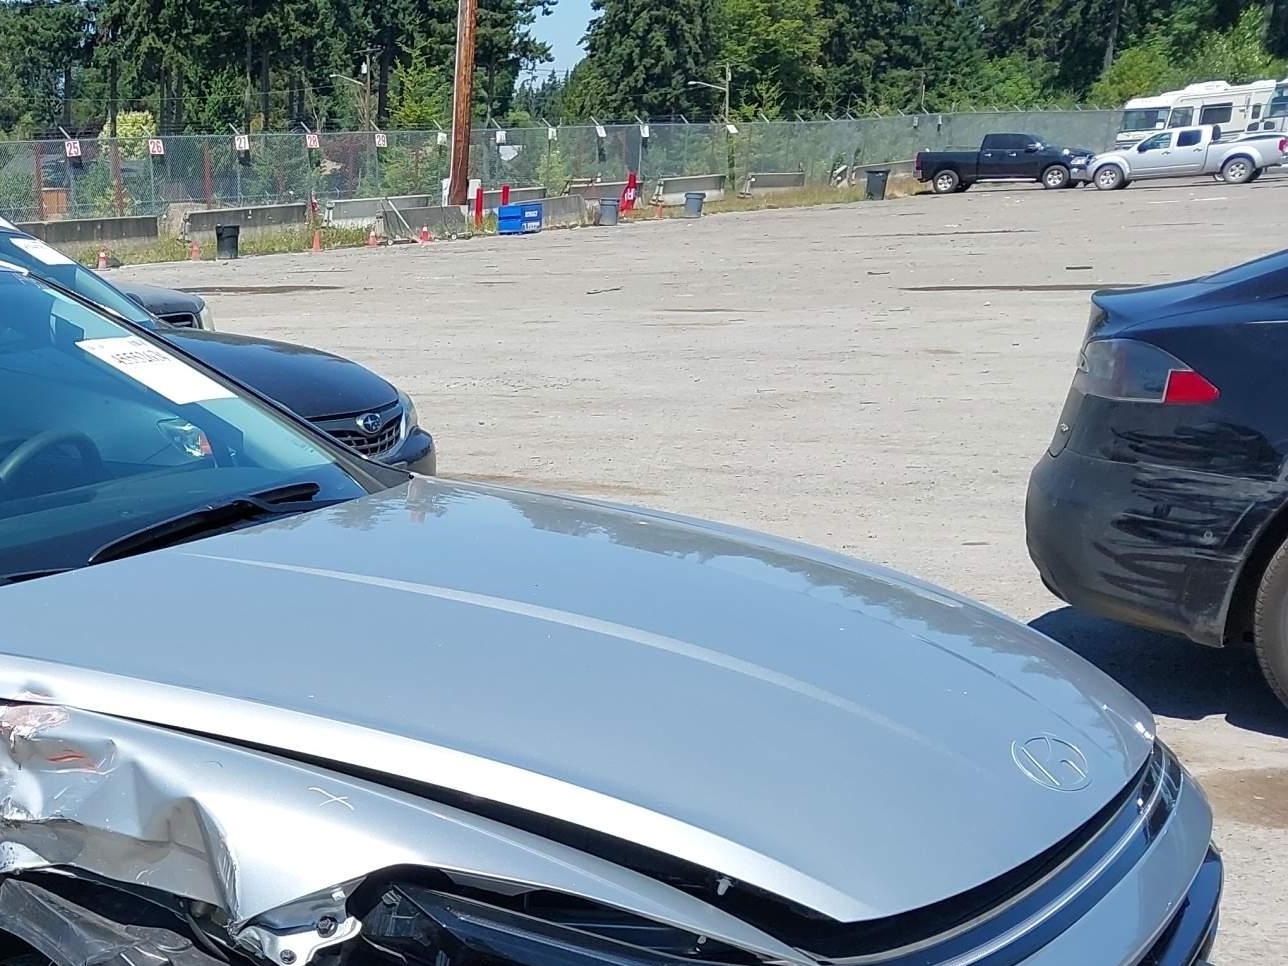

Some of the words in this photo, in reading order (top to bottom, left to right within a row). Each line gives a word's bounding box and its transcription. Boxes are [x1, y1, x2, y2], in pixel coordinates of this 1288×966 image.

[150, 140, 162, 153] 26
[376, 135, 386, 147] 29
[67, 142, 80, 155] 25
